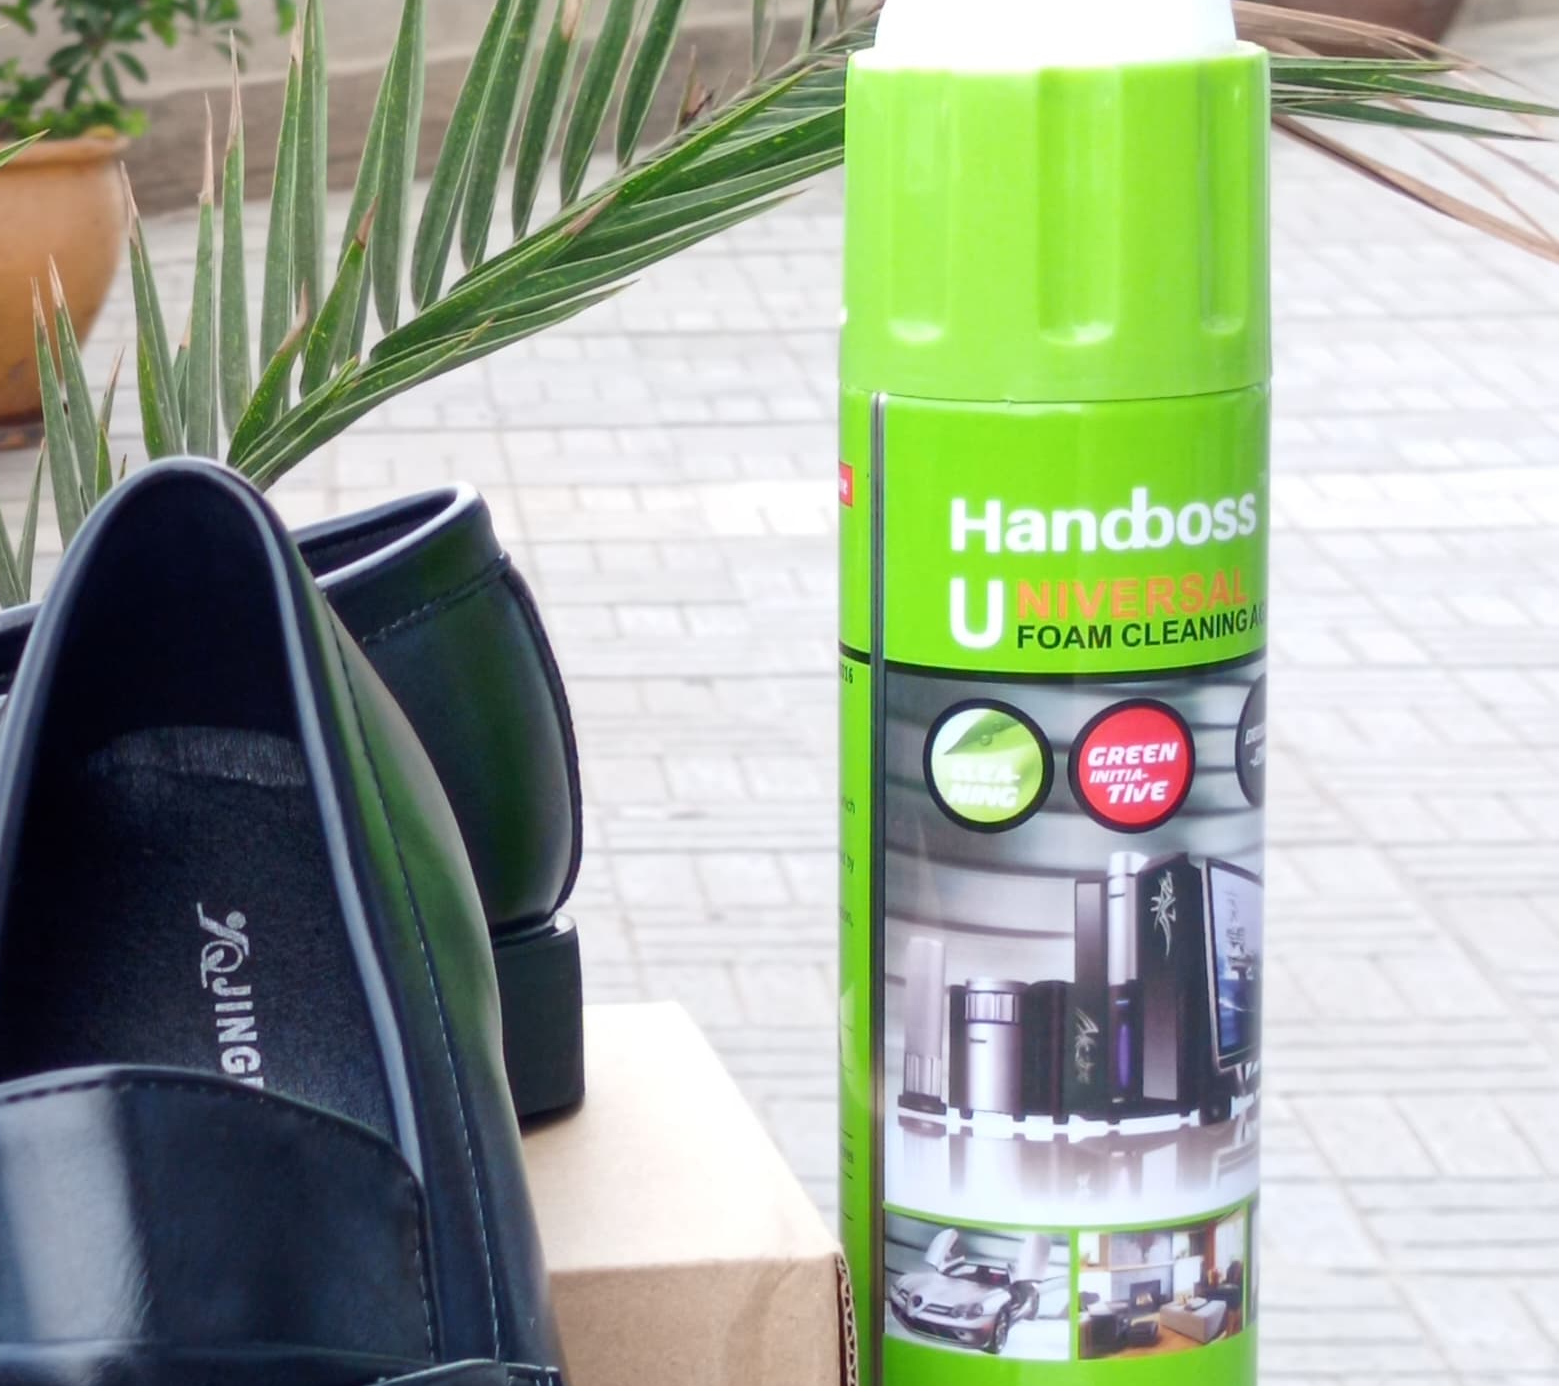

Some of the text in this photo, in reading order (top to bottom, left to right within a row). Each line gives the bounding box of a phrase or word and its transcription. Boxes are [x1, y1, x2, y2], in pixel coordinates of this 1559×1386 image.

[949, 487, 1257, 553] Handboss
[1017, 624, 1112, 650] FOAM
[1121, 608, 1248, 648] CLEANING
[1087, 741, 1179, 766] GREEN
[1089, 767, 1149, 784] INITIA-
